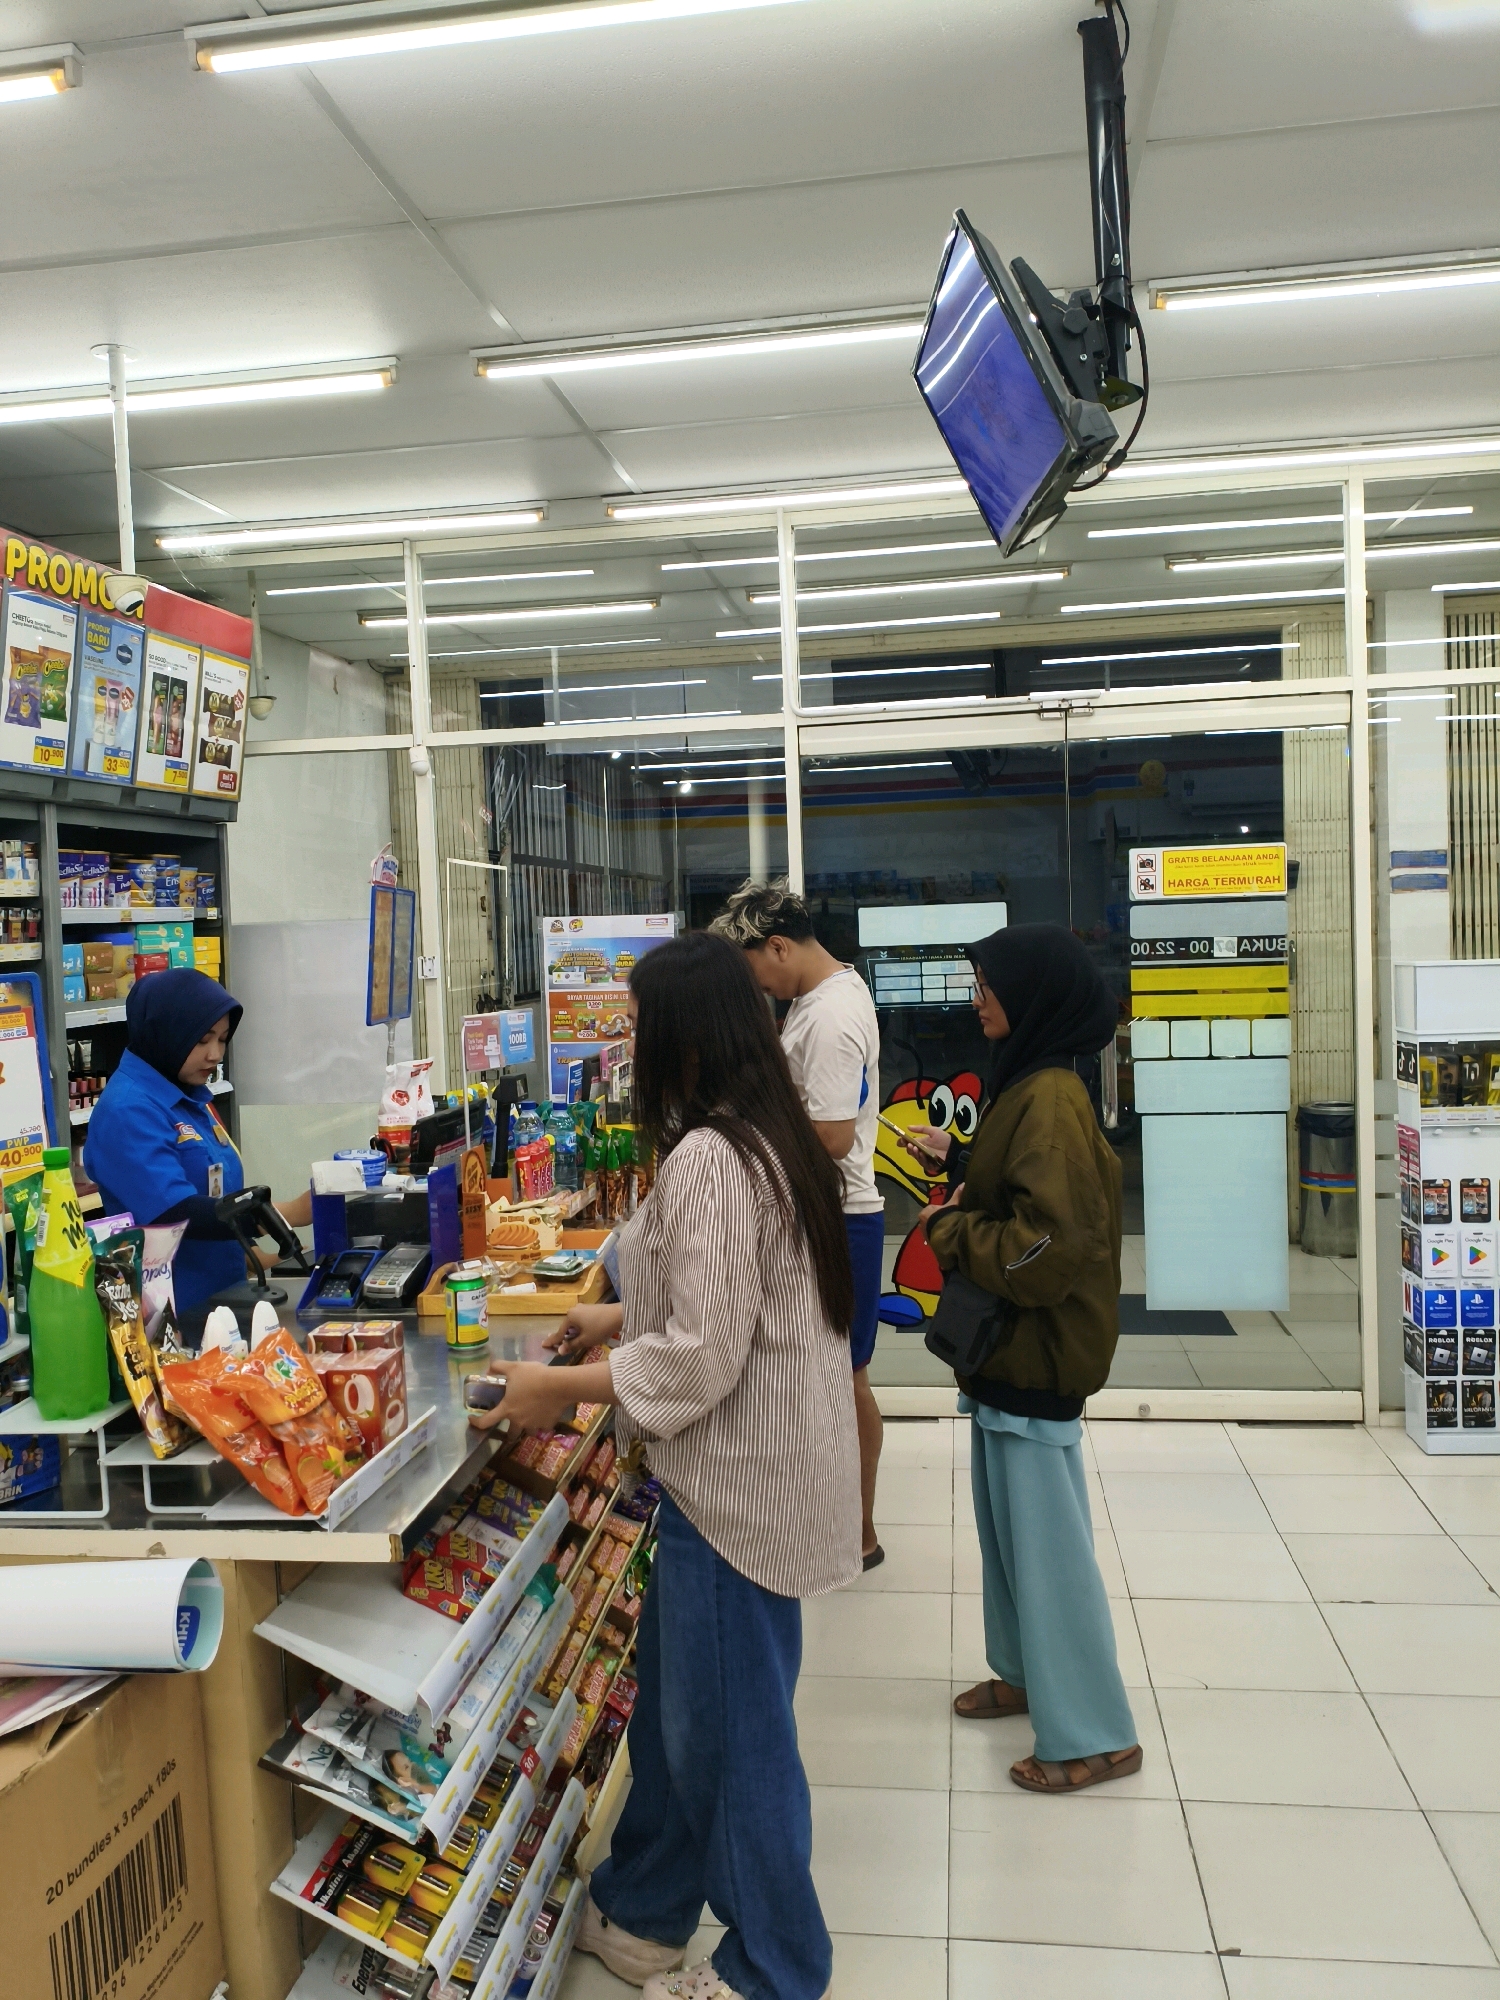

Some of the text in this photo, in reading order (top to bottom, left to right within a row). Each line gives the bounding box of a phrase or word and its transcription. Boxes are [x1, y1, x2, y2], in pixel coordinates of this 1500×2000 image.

[87, 621, 111, 635] PRODUK
[87, 631, 110, 647] BARU
[39, 748, 64, 762] 10.900
[106, 757, 130, 772] 33.500
[1168, 856, 1199, 864] GRATIS
[1202, 854, 1253, 863] BELANJAAN
[1168, 875, 1281, 888] HARGA TERMURAH
[7, 1136, 30, 1148] PWP
[0, 1145, 42, 1167] 40.900
[449, 1530, 471, 1562] UNO
[423, 1559, 447, 1592] UNO
[410, 1586, 430, 1598] UNO
[45, 1758, 177, 1906] 20 bundles x 3 pack 180s
[341, 1831, 370, 1869] Alkaline
